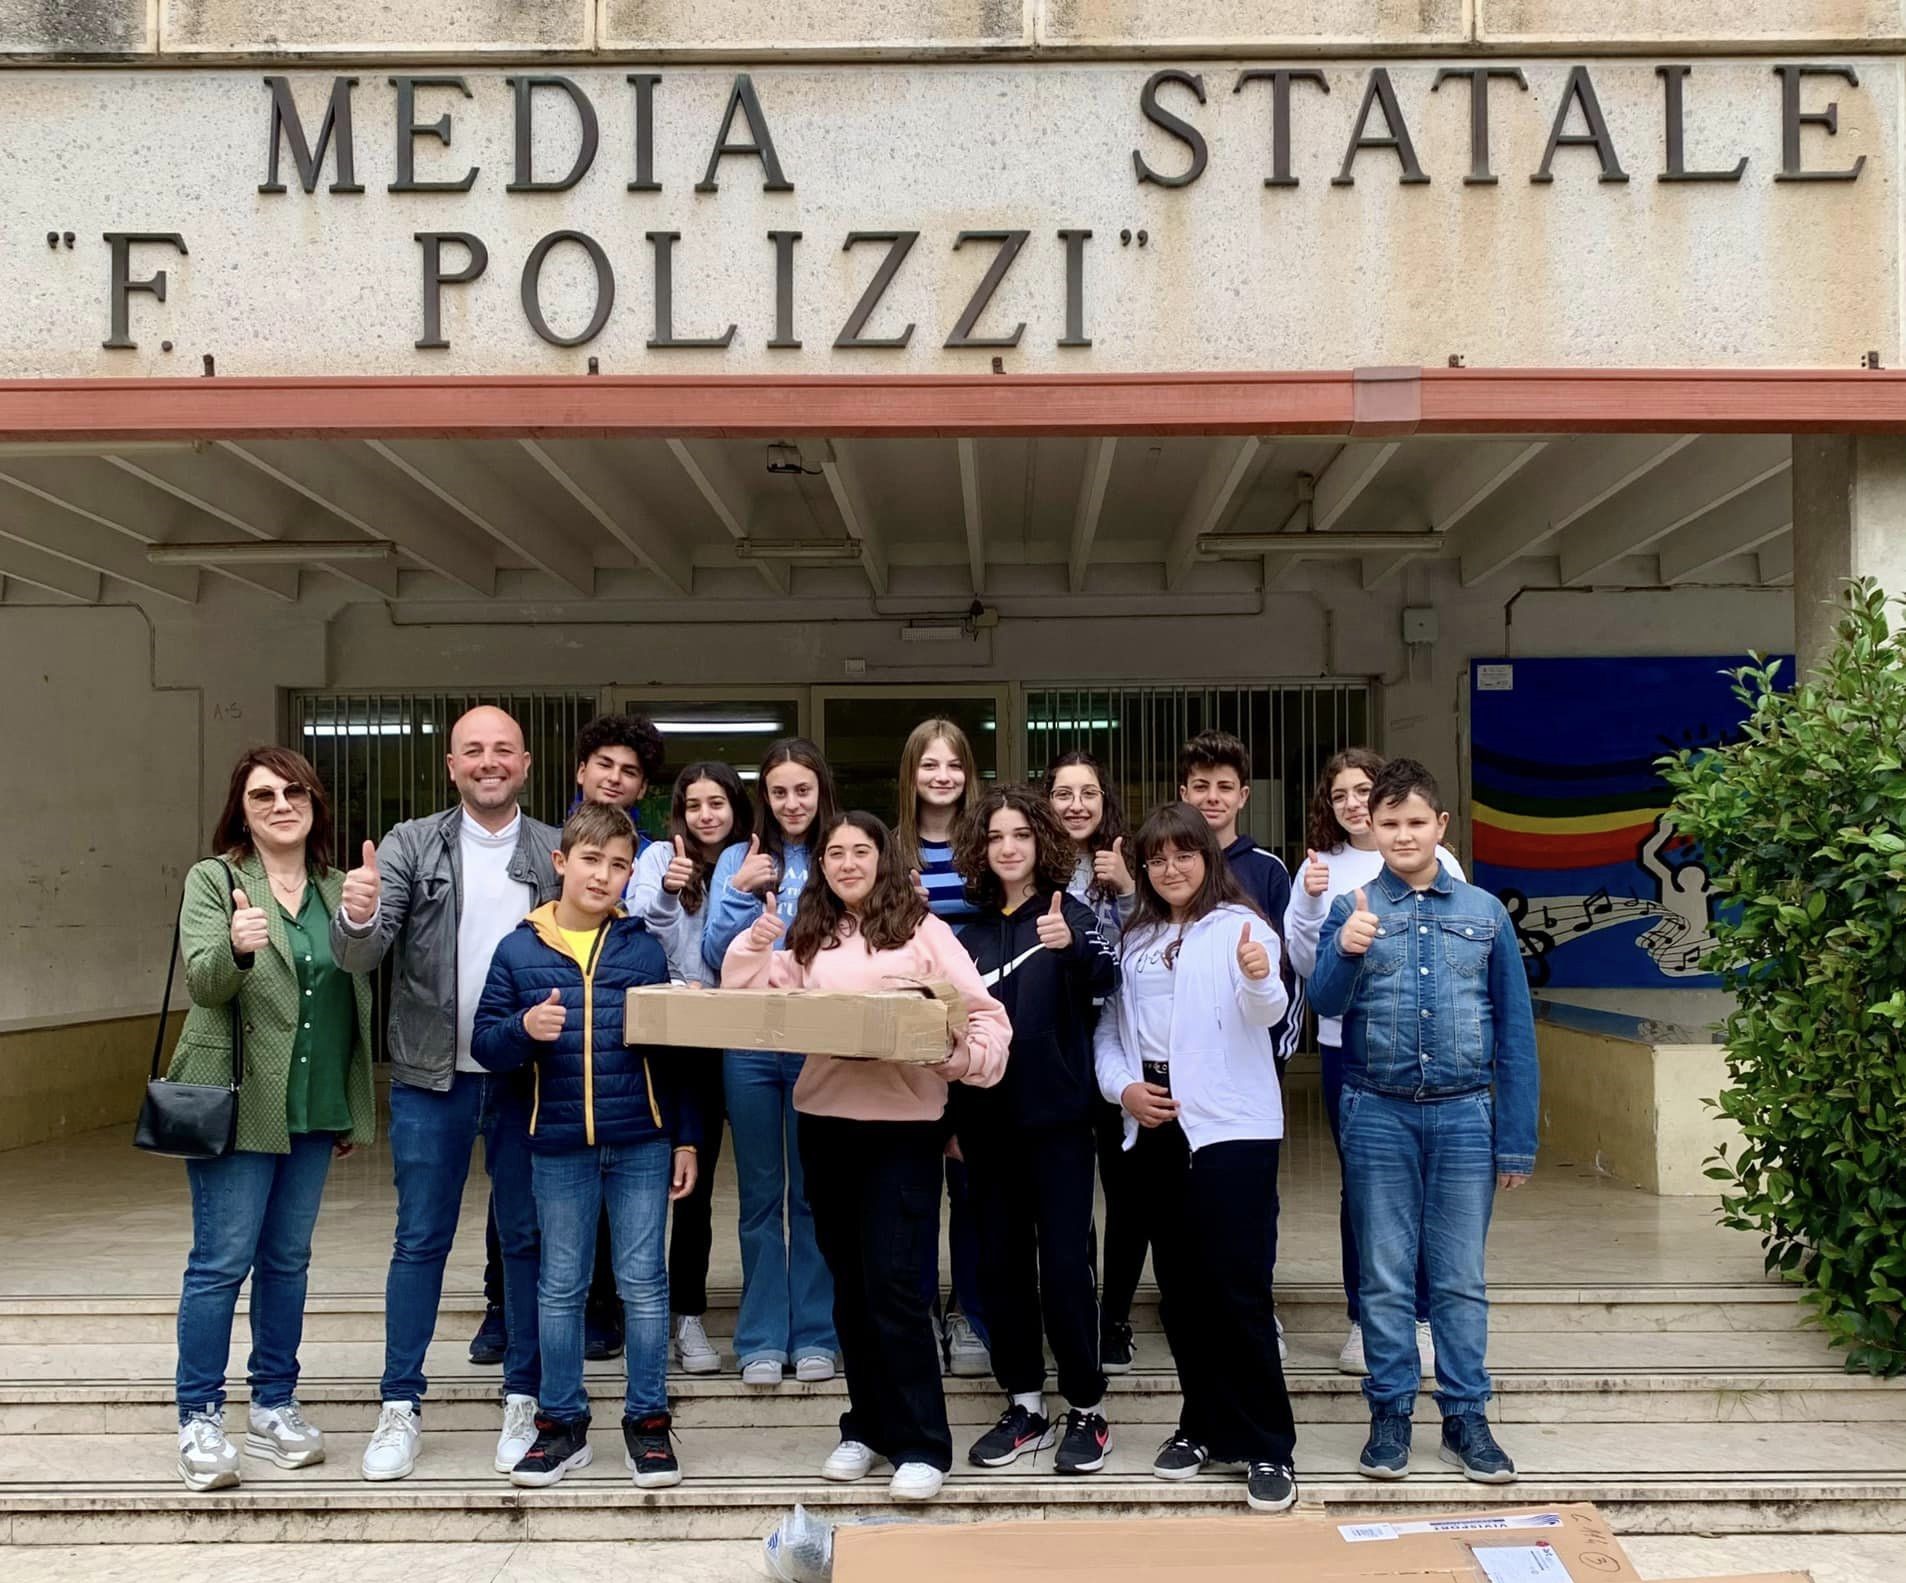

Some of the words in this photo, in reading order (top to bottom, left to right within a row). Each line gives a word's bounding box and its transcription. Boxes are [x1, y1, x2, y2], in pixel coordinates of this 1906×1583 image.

[258, 73, 796, 196] MEDIA
[1132, 64, 1867, 191] STATALE
[413, 229, 1149, 351] POLIZZI"
